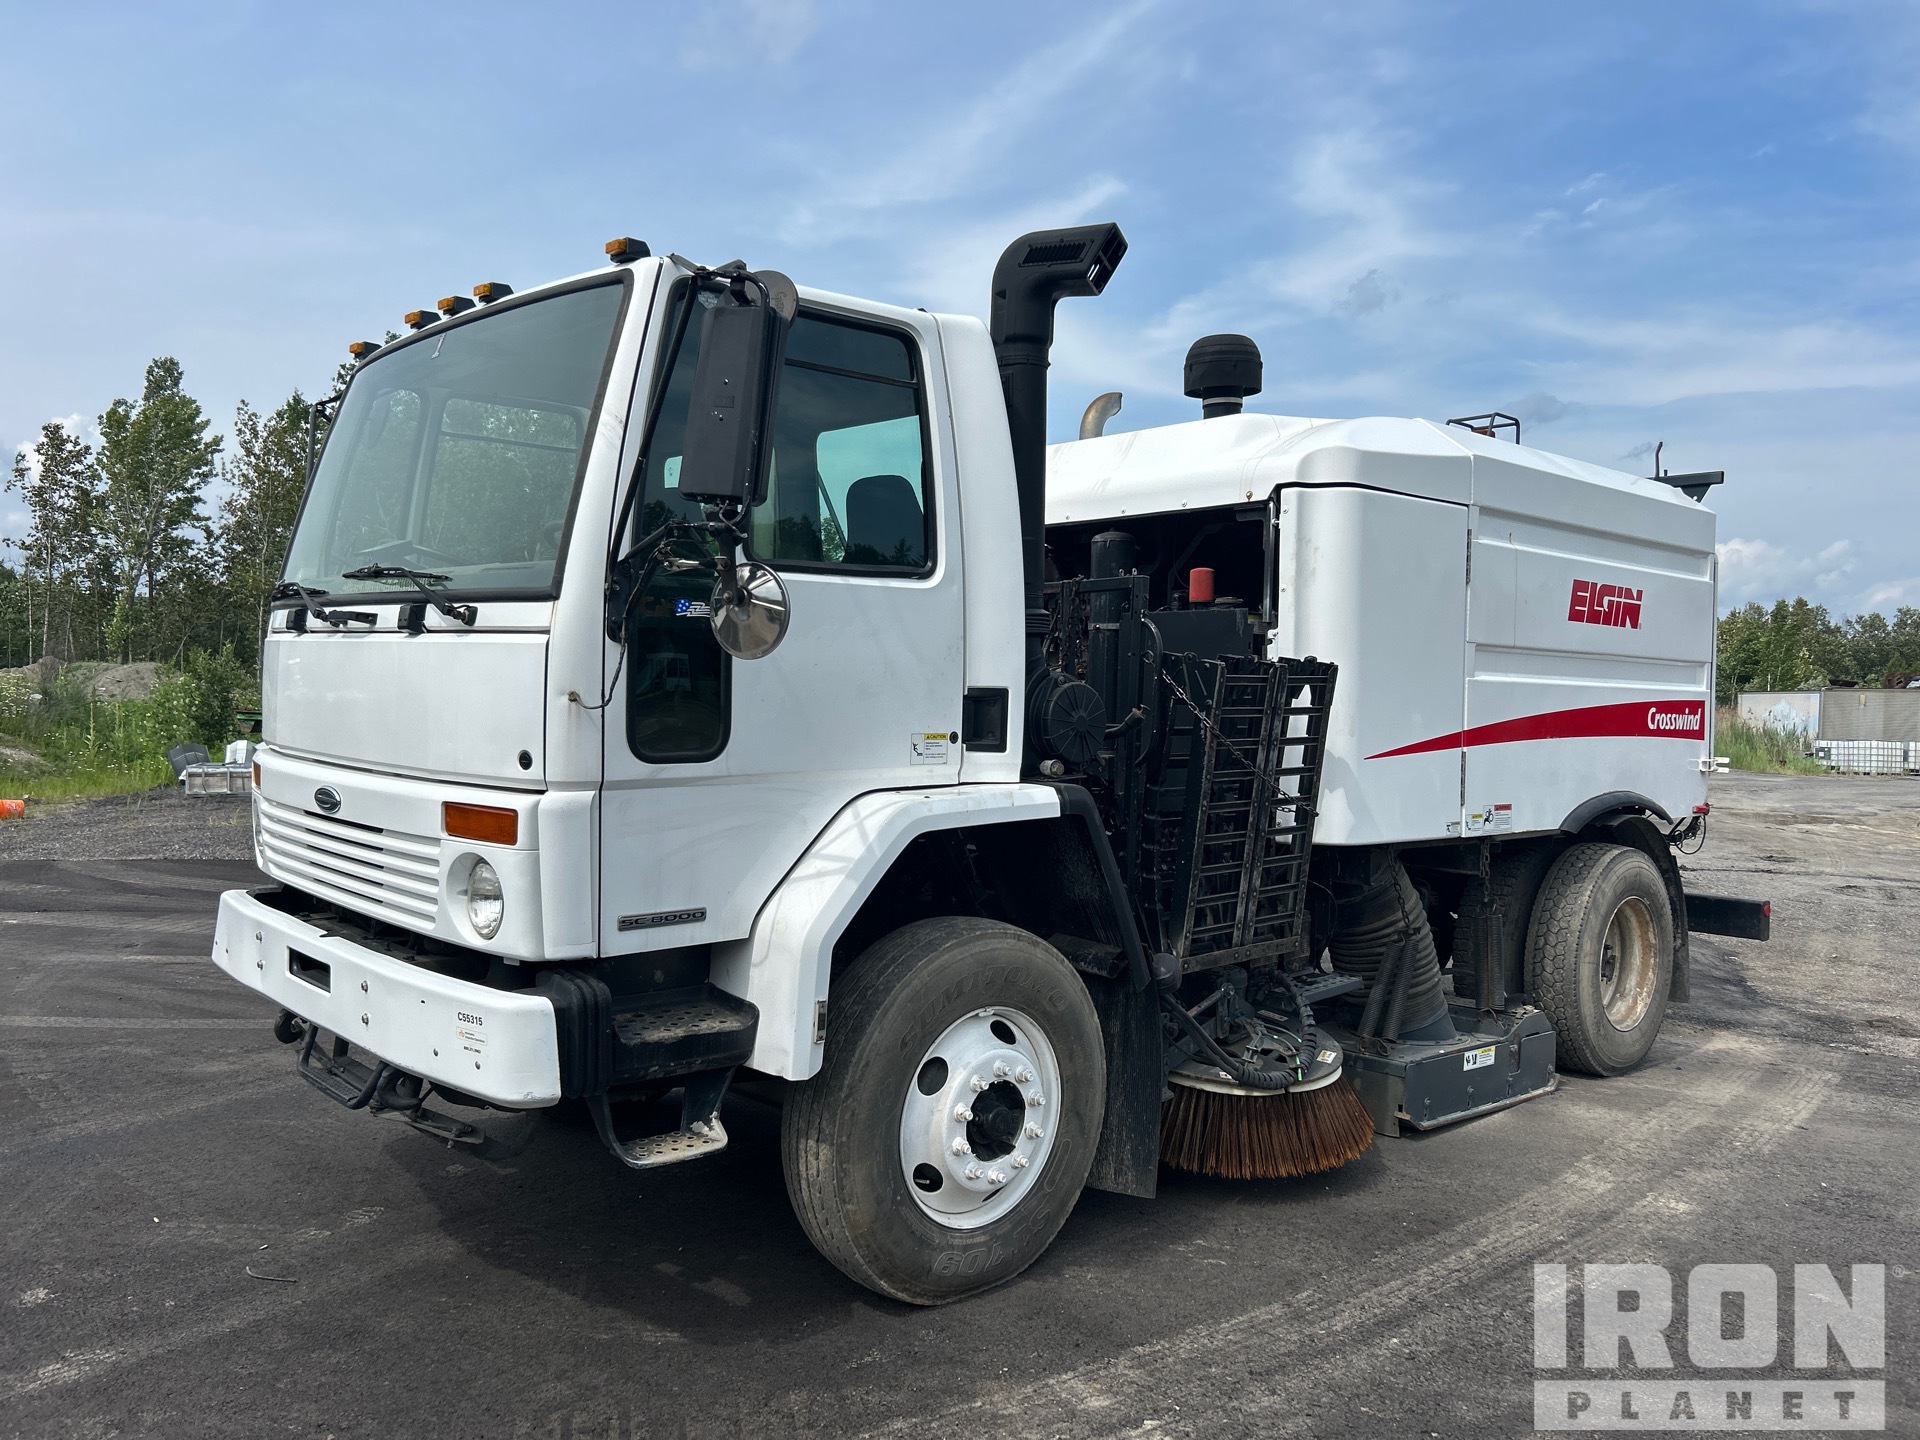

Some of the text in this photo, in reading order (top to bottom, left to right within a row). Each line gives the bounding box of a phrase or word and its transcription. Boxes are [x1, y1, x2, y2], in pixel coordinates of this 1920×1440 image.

[1568, 579, 1643, 629] ELGIN
[1648, 707, 1701, 730] Crosswind
[457, 1011, 483, 1026] C55315
[900, 965, 1069, 1062] SUMITOMO
